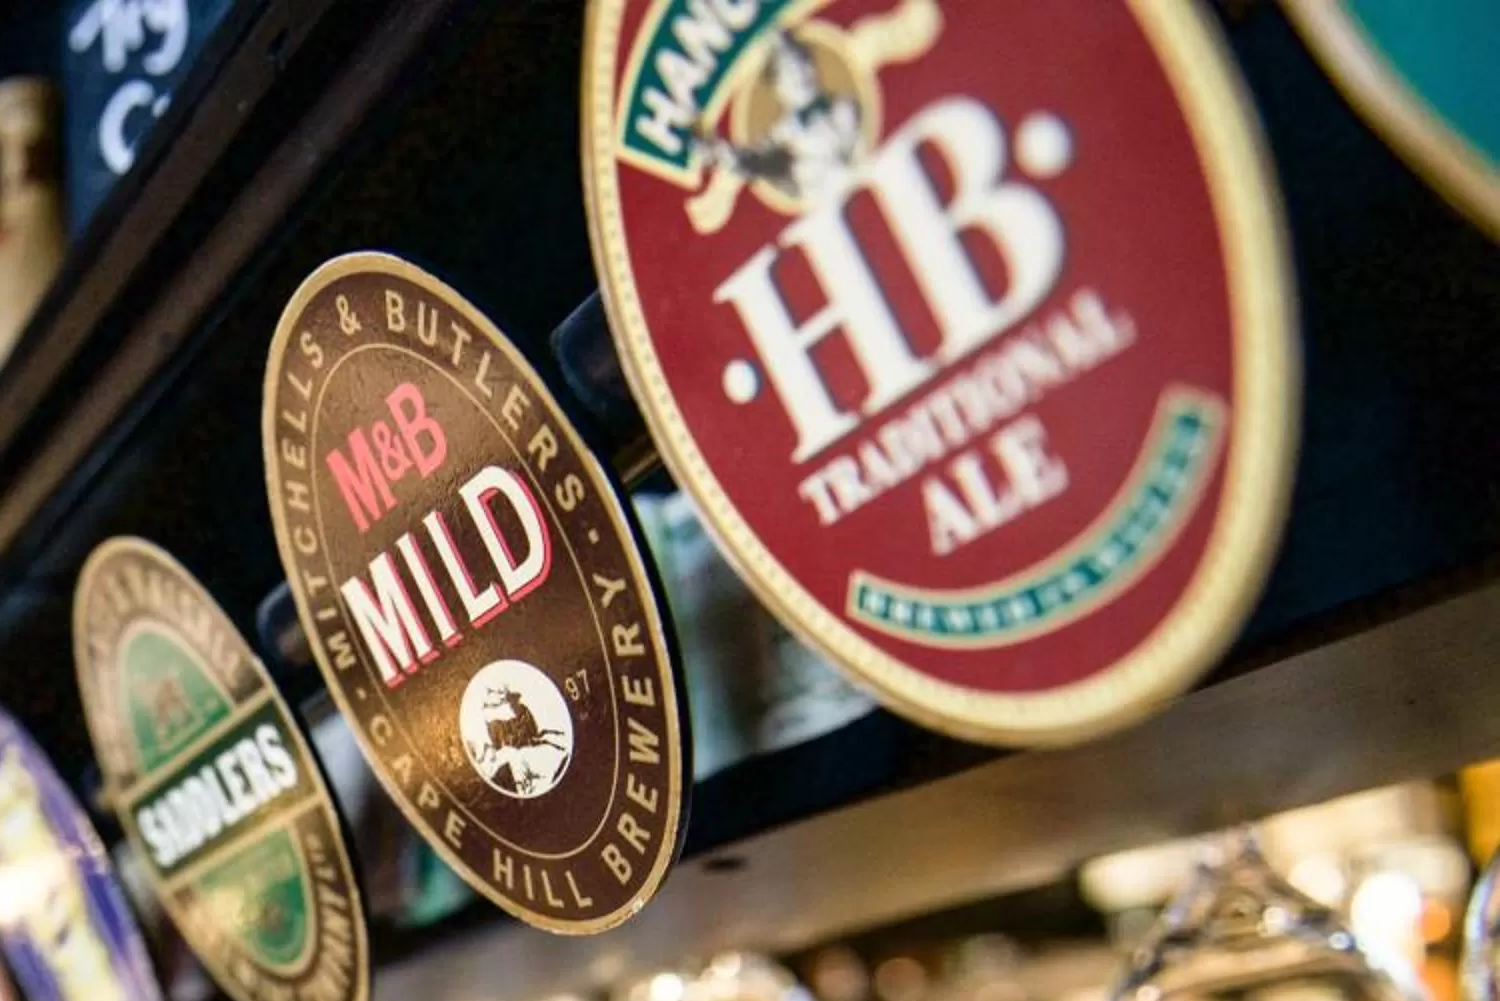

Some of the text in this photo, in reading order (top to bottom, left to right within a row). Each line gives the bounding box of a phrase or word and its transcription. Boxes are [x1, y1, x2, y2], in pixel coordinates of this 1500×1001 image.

[282, 289, 585, 670] MITCHELLS & BUTLERS
[326, 383, 448, 534] M&B
[798, 285, 1138, 526] TRADITIONAL
[920, 412, 1070, 558] ALE
[340, 465, 553, 688] MILD
[138, 724, 298, 868] SADDLERS
[369, 573, 661, 909] CAPE HILL BREWERY
